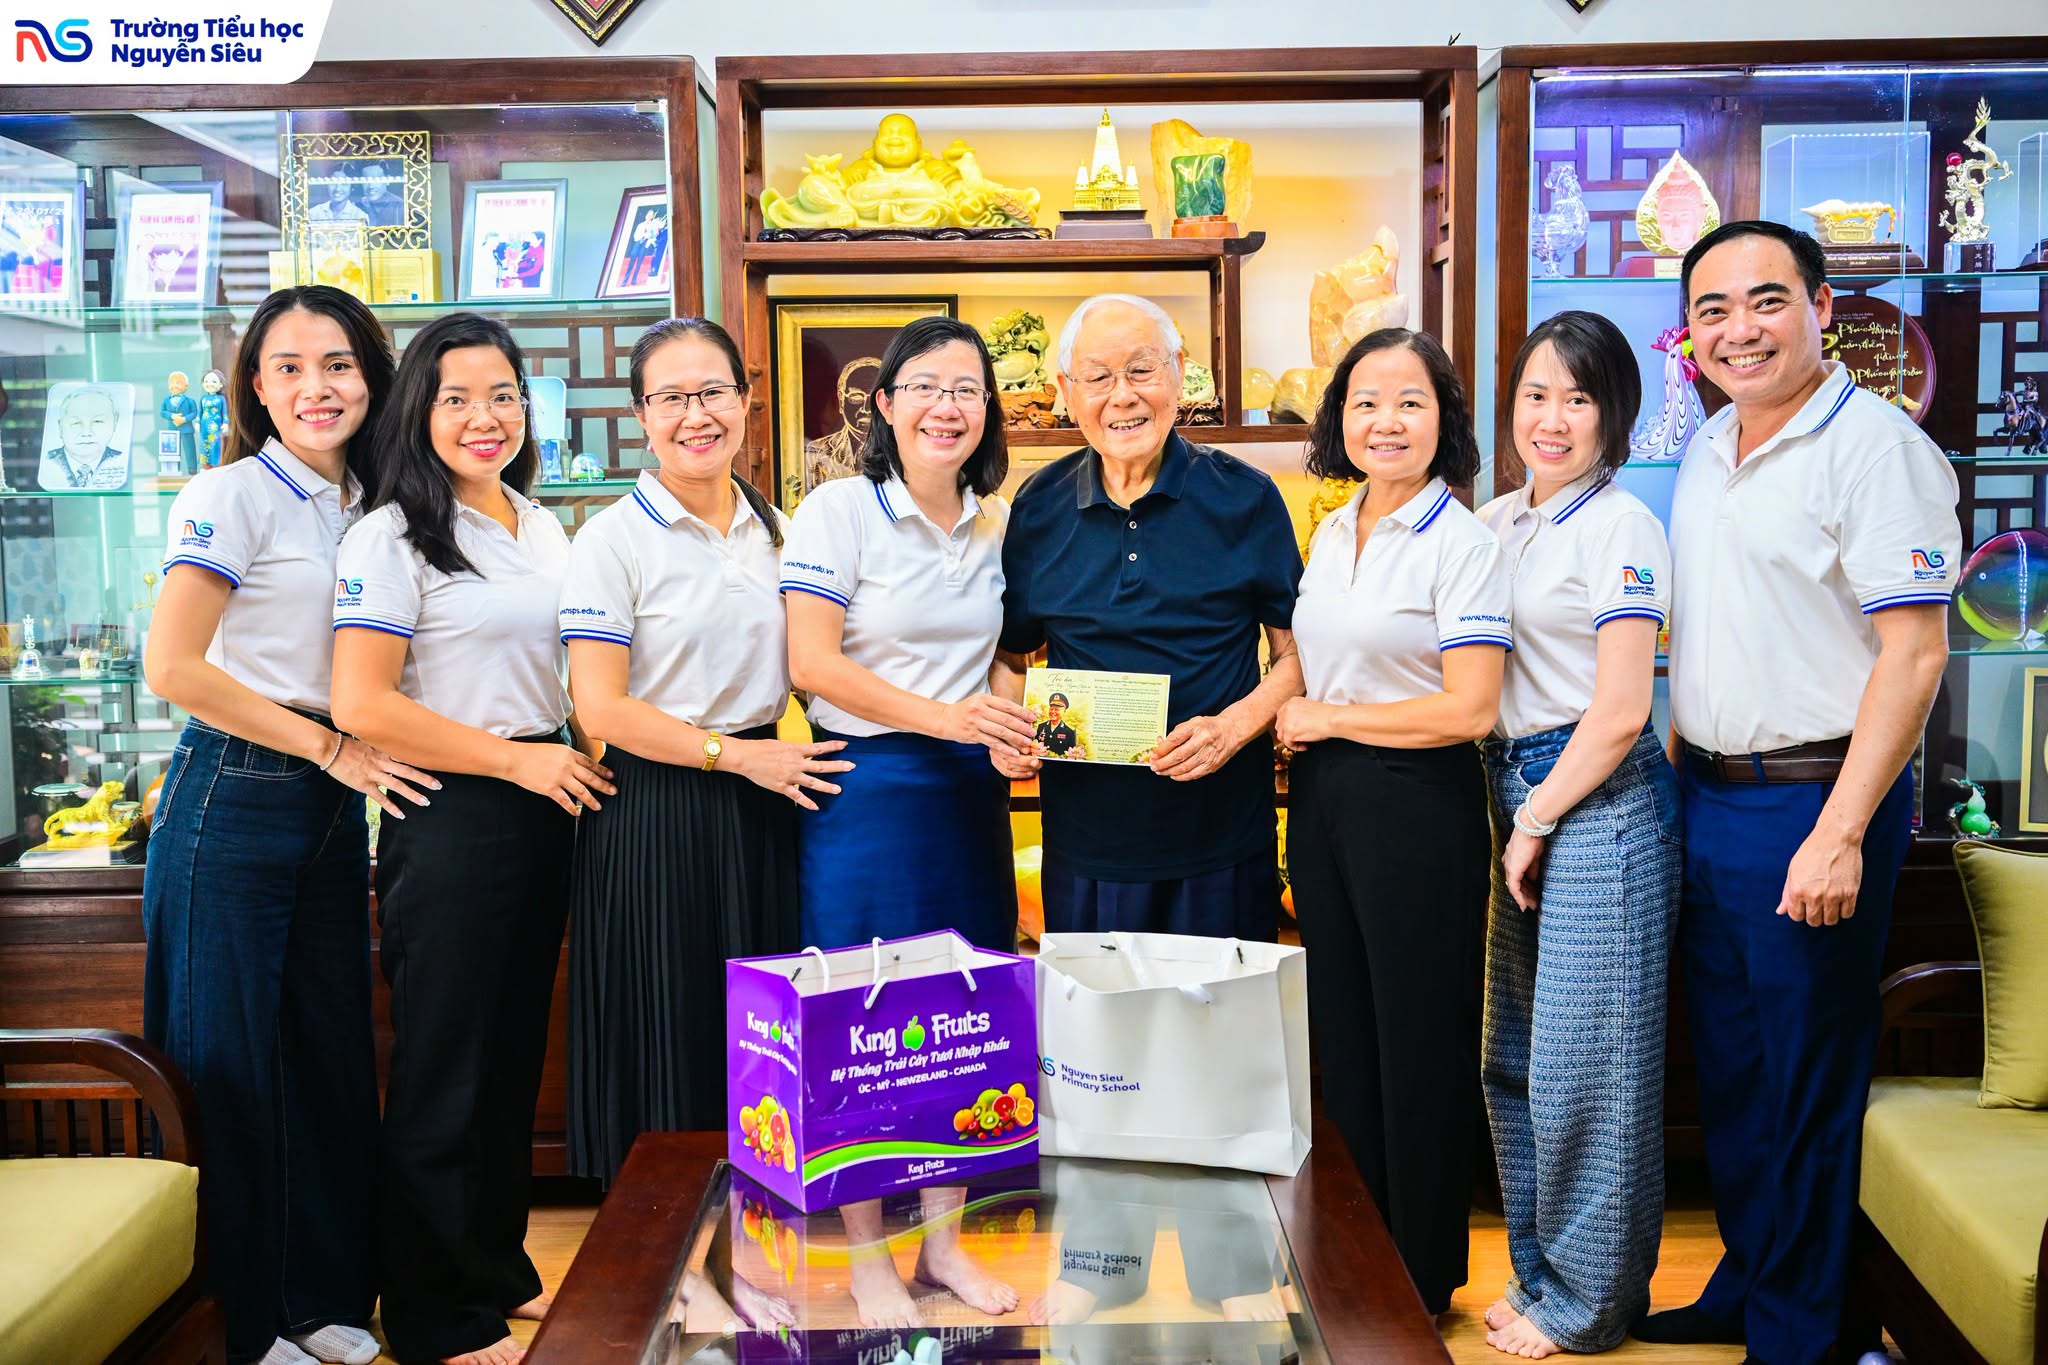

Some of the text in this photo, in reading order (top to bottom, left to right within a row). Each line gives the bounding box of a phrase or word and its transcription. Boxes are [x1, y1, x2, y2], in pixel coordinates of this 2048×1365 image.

[747, 1011, 768, 1040] King
[850, 1010, 990, 1057] King Fruits
[830, 1036, 1010, 1083] Hệ Thống Trái Cây Tươi Nhập Khẩu
[1061, 1064, 1124, 1082] Nguyen Sieu
[858, 1082, 871, 1094] ÚC
[877, 1078, 890, 1092] MỸ
[896, 1070, 948, 1088] NEWZELAND
[954, 1062, 987, 1076] CANADA
[1062, 1074, 1140, 1093] Primary School
